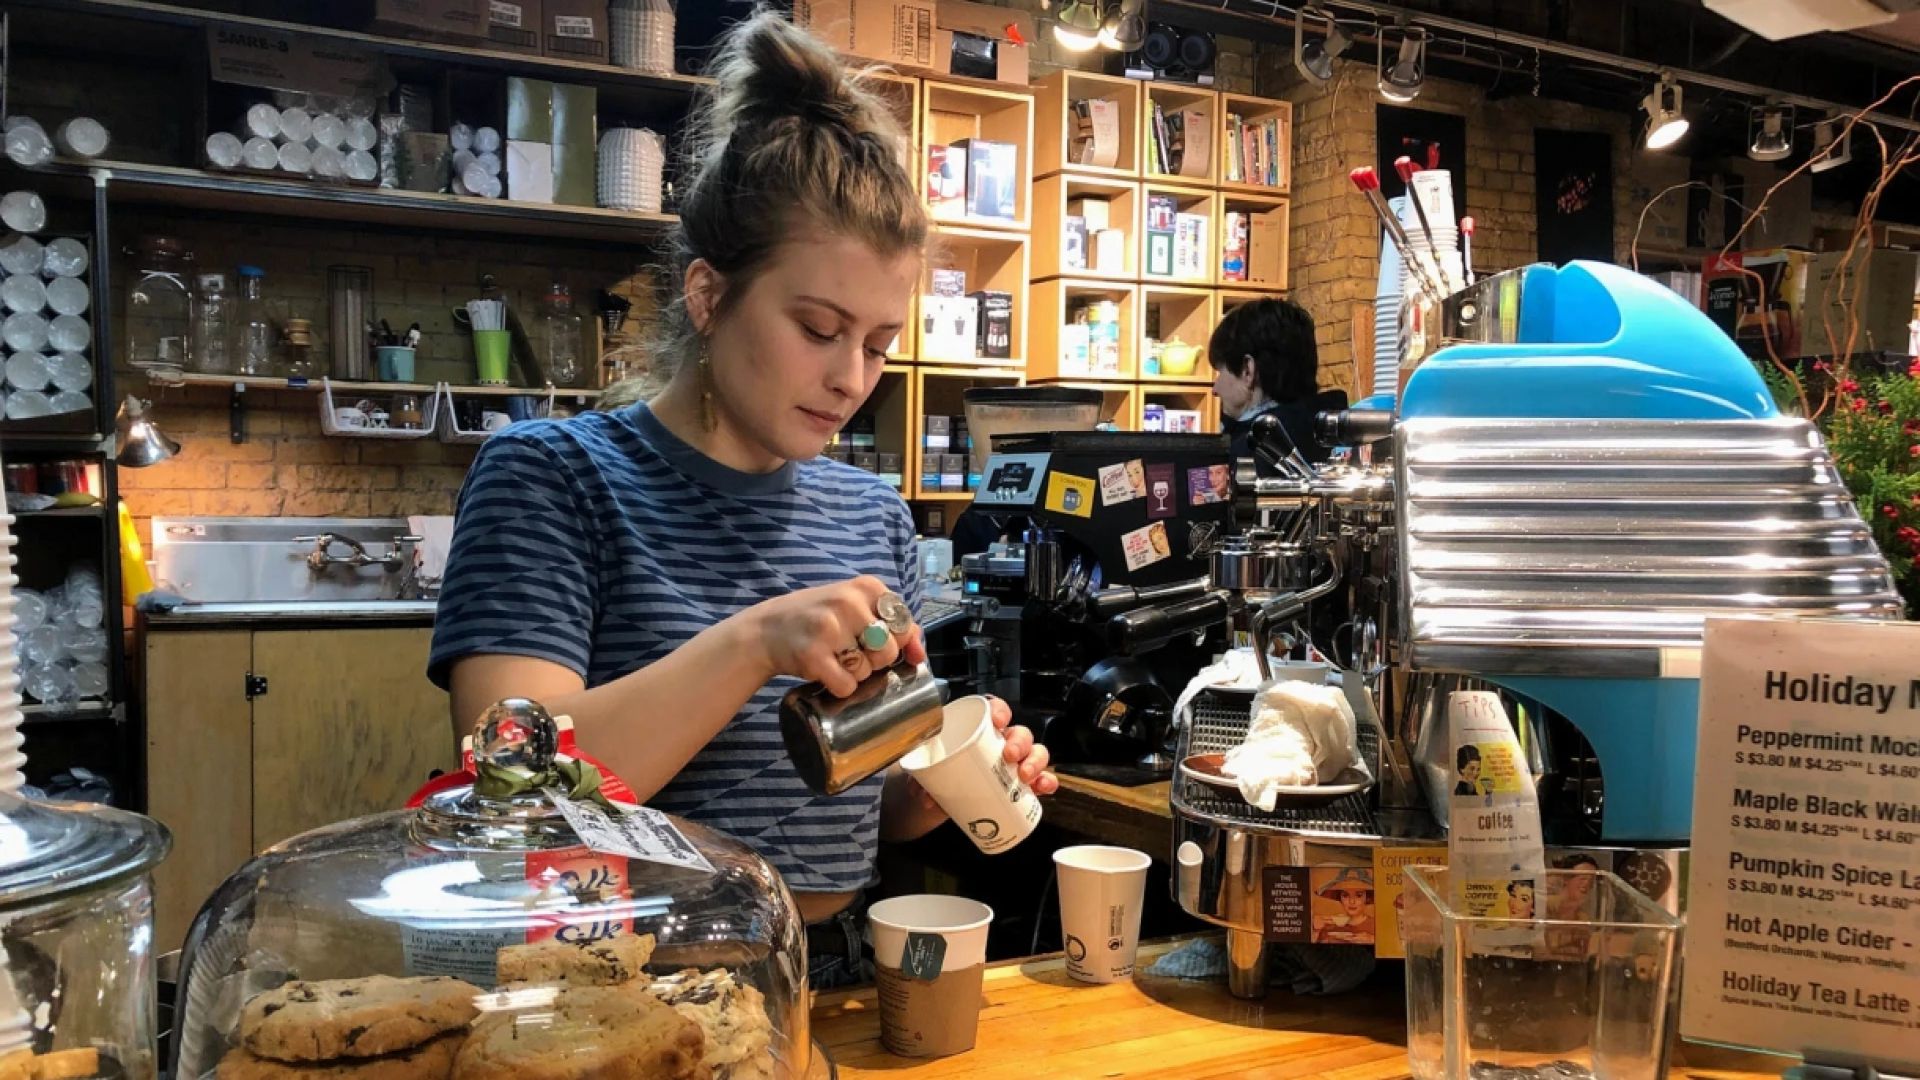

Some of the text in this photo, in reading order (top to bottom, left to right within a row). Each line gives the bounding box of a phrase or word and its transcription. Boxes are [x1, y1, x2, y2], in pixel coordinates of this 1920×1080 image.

[1764, 670, 1897, 714] Holiday
[1737, 725, 1863, 752] Peppermint
[1735, 751, 1744, 764] S
[1747, 752, 1785, 767] $3.80
[1788, 755, 1802, 768] M
[1867, 762, 1876, 775] L
[1733, 788, 1799, 813] Maple
[1806, 794, 1868, 818] Black
[1478, 811, 1513, 830] coffee
[1731, 814, 1740, 827] S
[1744, 816, 1781, 831] $3.80
[1784, 820, 1797, 832] M
[1862, 827, 1871, 840] L
[1729, 851, 1824, 879] Pumpkin
[1832, 862, 1893, 887] Spice
[1464, 892, 1498, 900] COFFEE
[1728, 877, 1737, 890] S
[1740, 879, 1776, 894] $3.80
[1780, 883, 1793, 897] M
[1858, 892, 1867, 905] L
[1726, 912, 1762, 934] Hot
[1767, 918, 1829, 944] Apple
[1836, 926, 1896, 951] Cider
[1722, 970, 1910, 1013] Holiday Tea Latte
